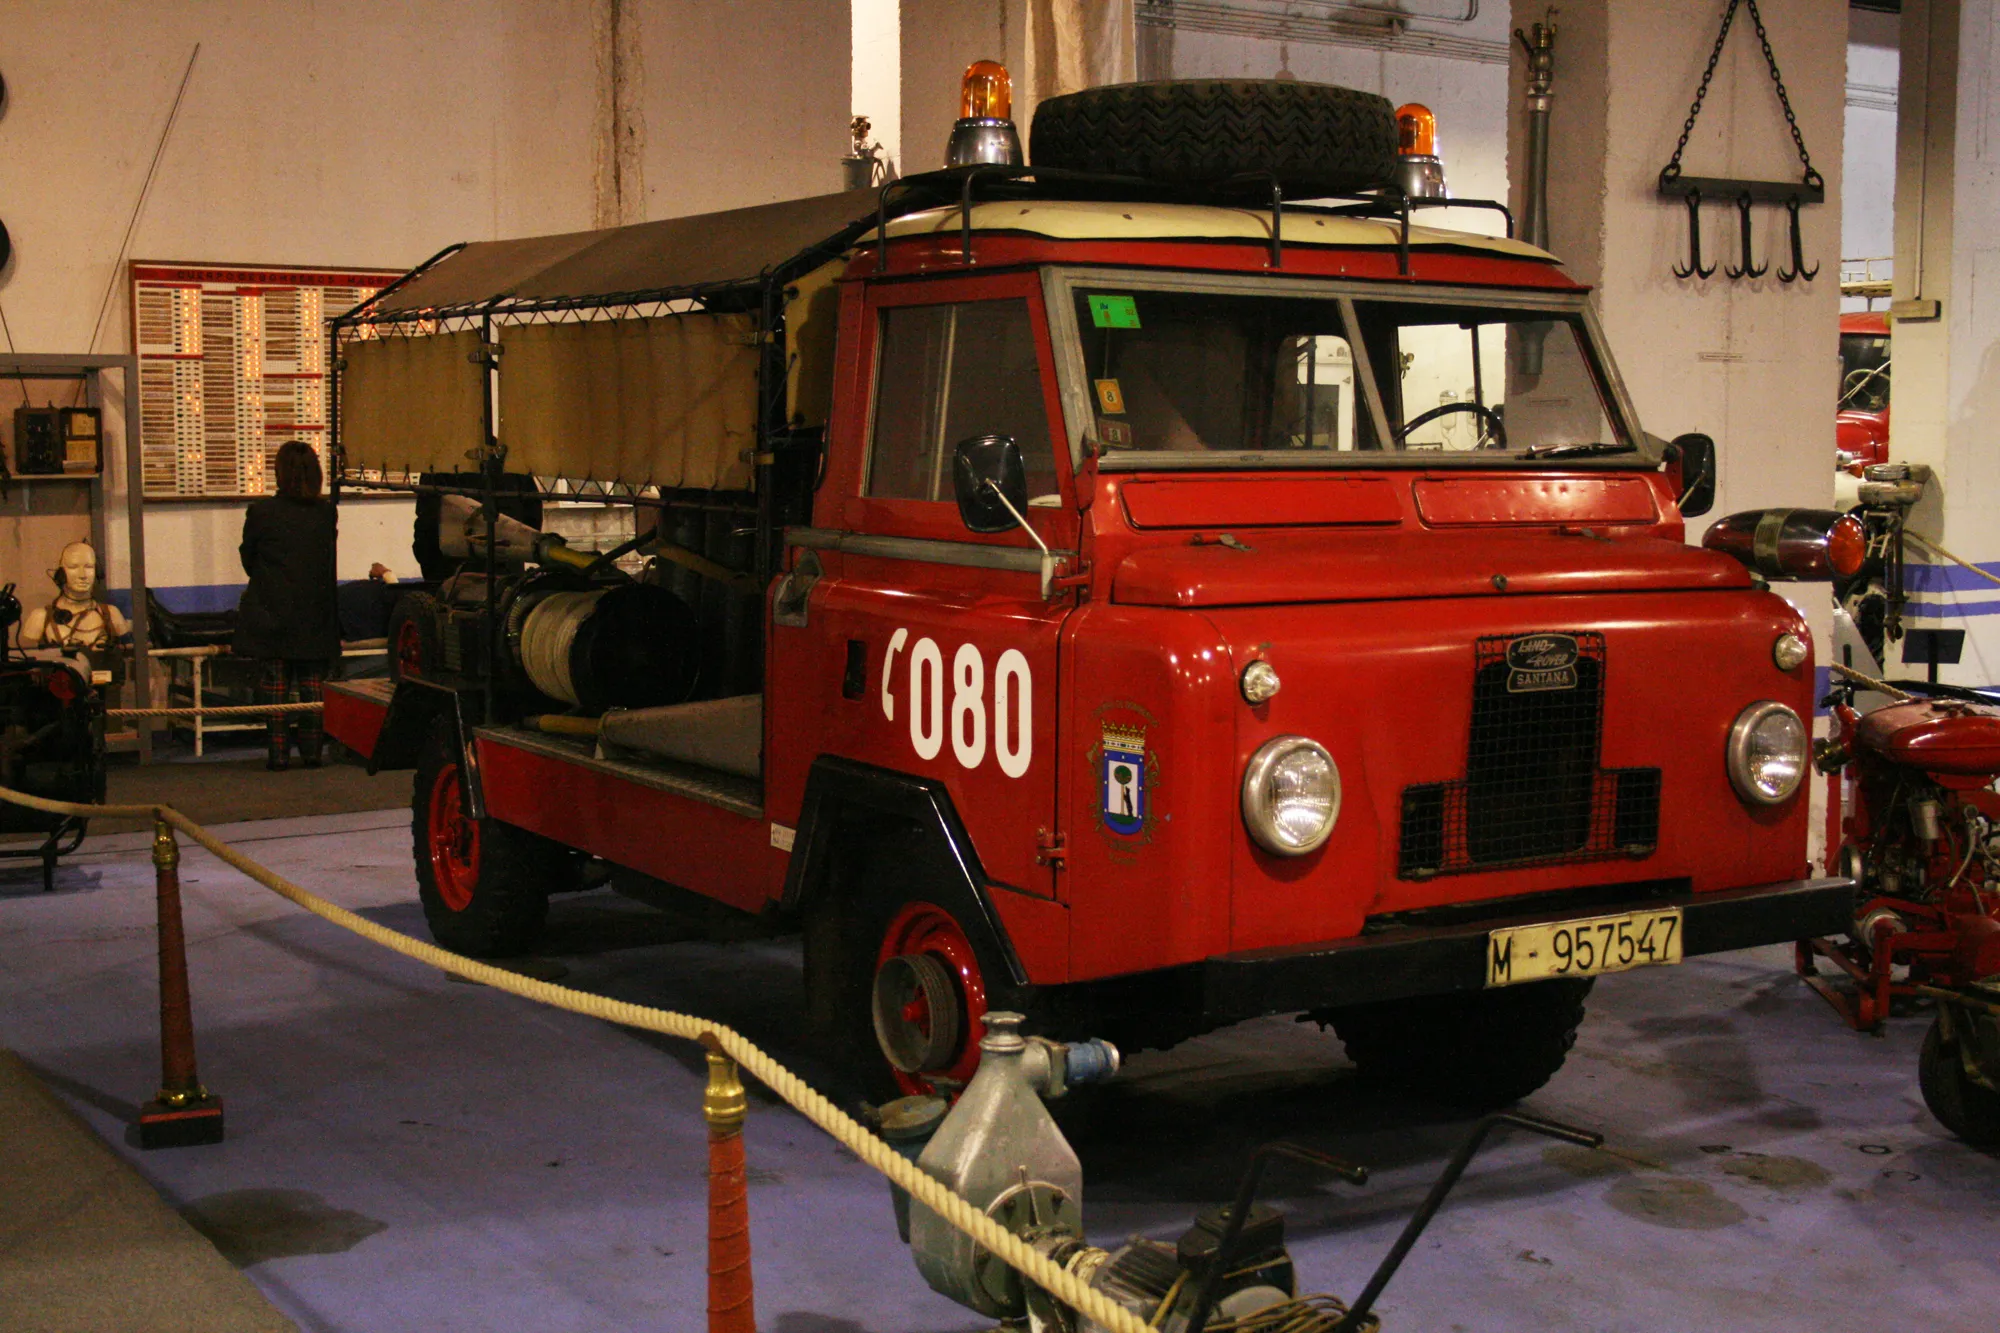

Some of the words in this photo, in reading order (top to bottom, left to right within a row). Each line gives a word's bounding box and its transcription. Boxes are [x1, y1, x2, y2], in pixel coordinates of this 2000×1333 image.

[1518, 639, 1550, 653] LAND
[1533, 654, 1569, 667] ROVER
[1516, 671, 1569, 685] SANTANA
[910, 637, 1032, 779] 080
